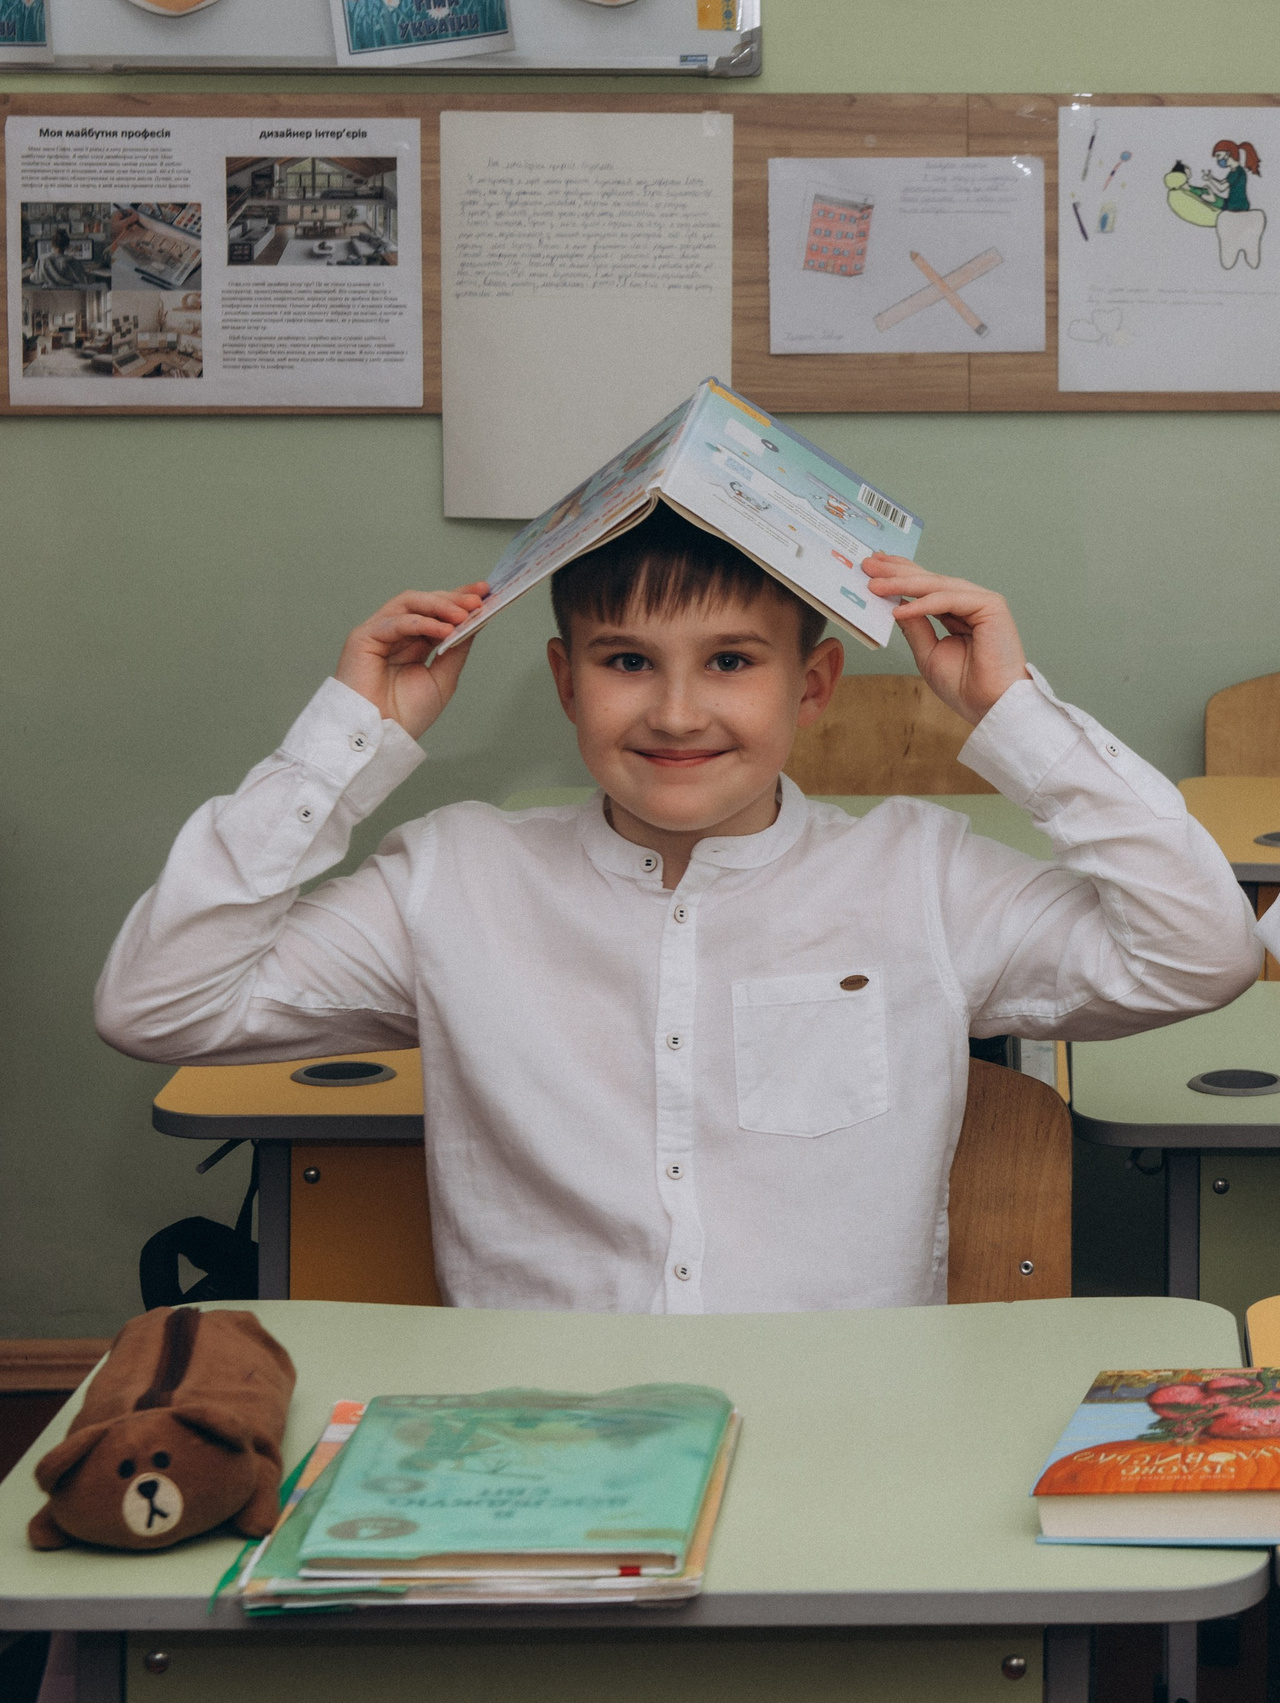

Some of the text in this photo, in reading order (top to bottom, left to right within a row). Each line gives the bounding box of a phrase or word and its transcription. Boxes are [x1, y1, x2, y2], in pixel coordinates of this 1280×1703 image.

[398, 13, 480, 39] УКРАЇНИ
[39, 127, 171, 140] Моя майбутня професія
[259, 128, 312, 140] дизайнер
